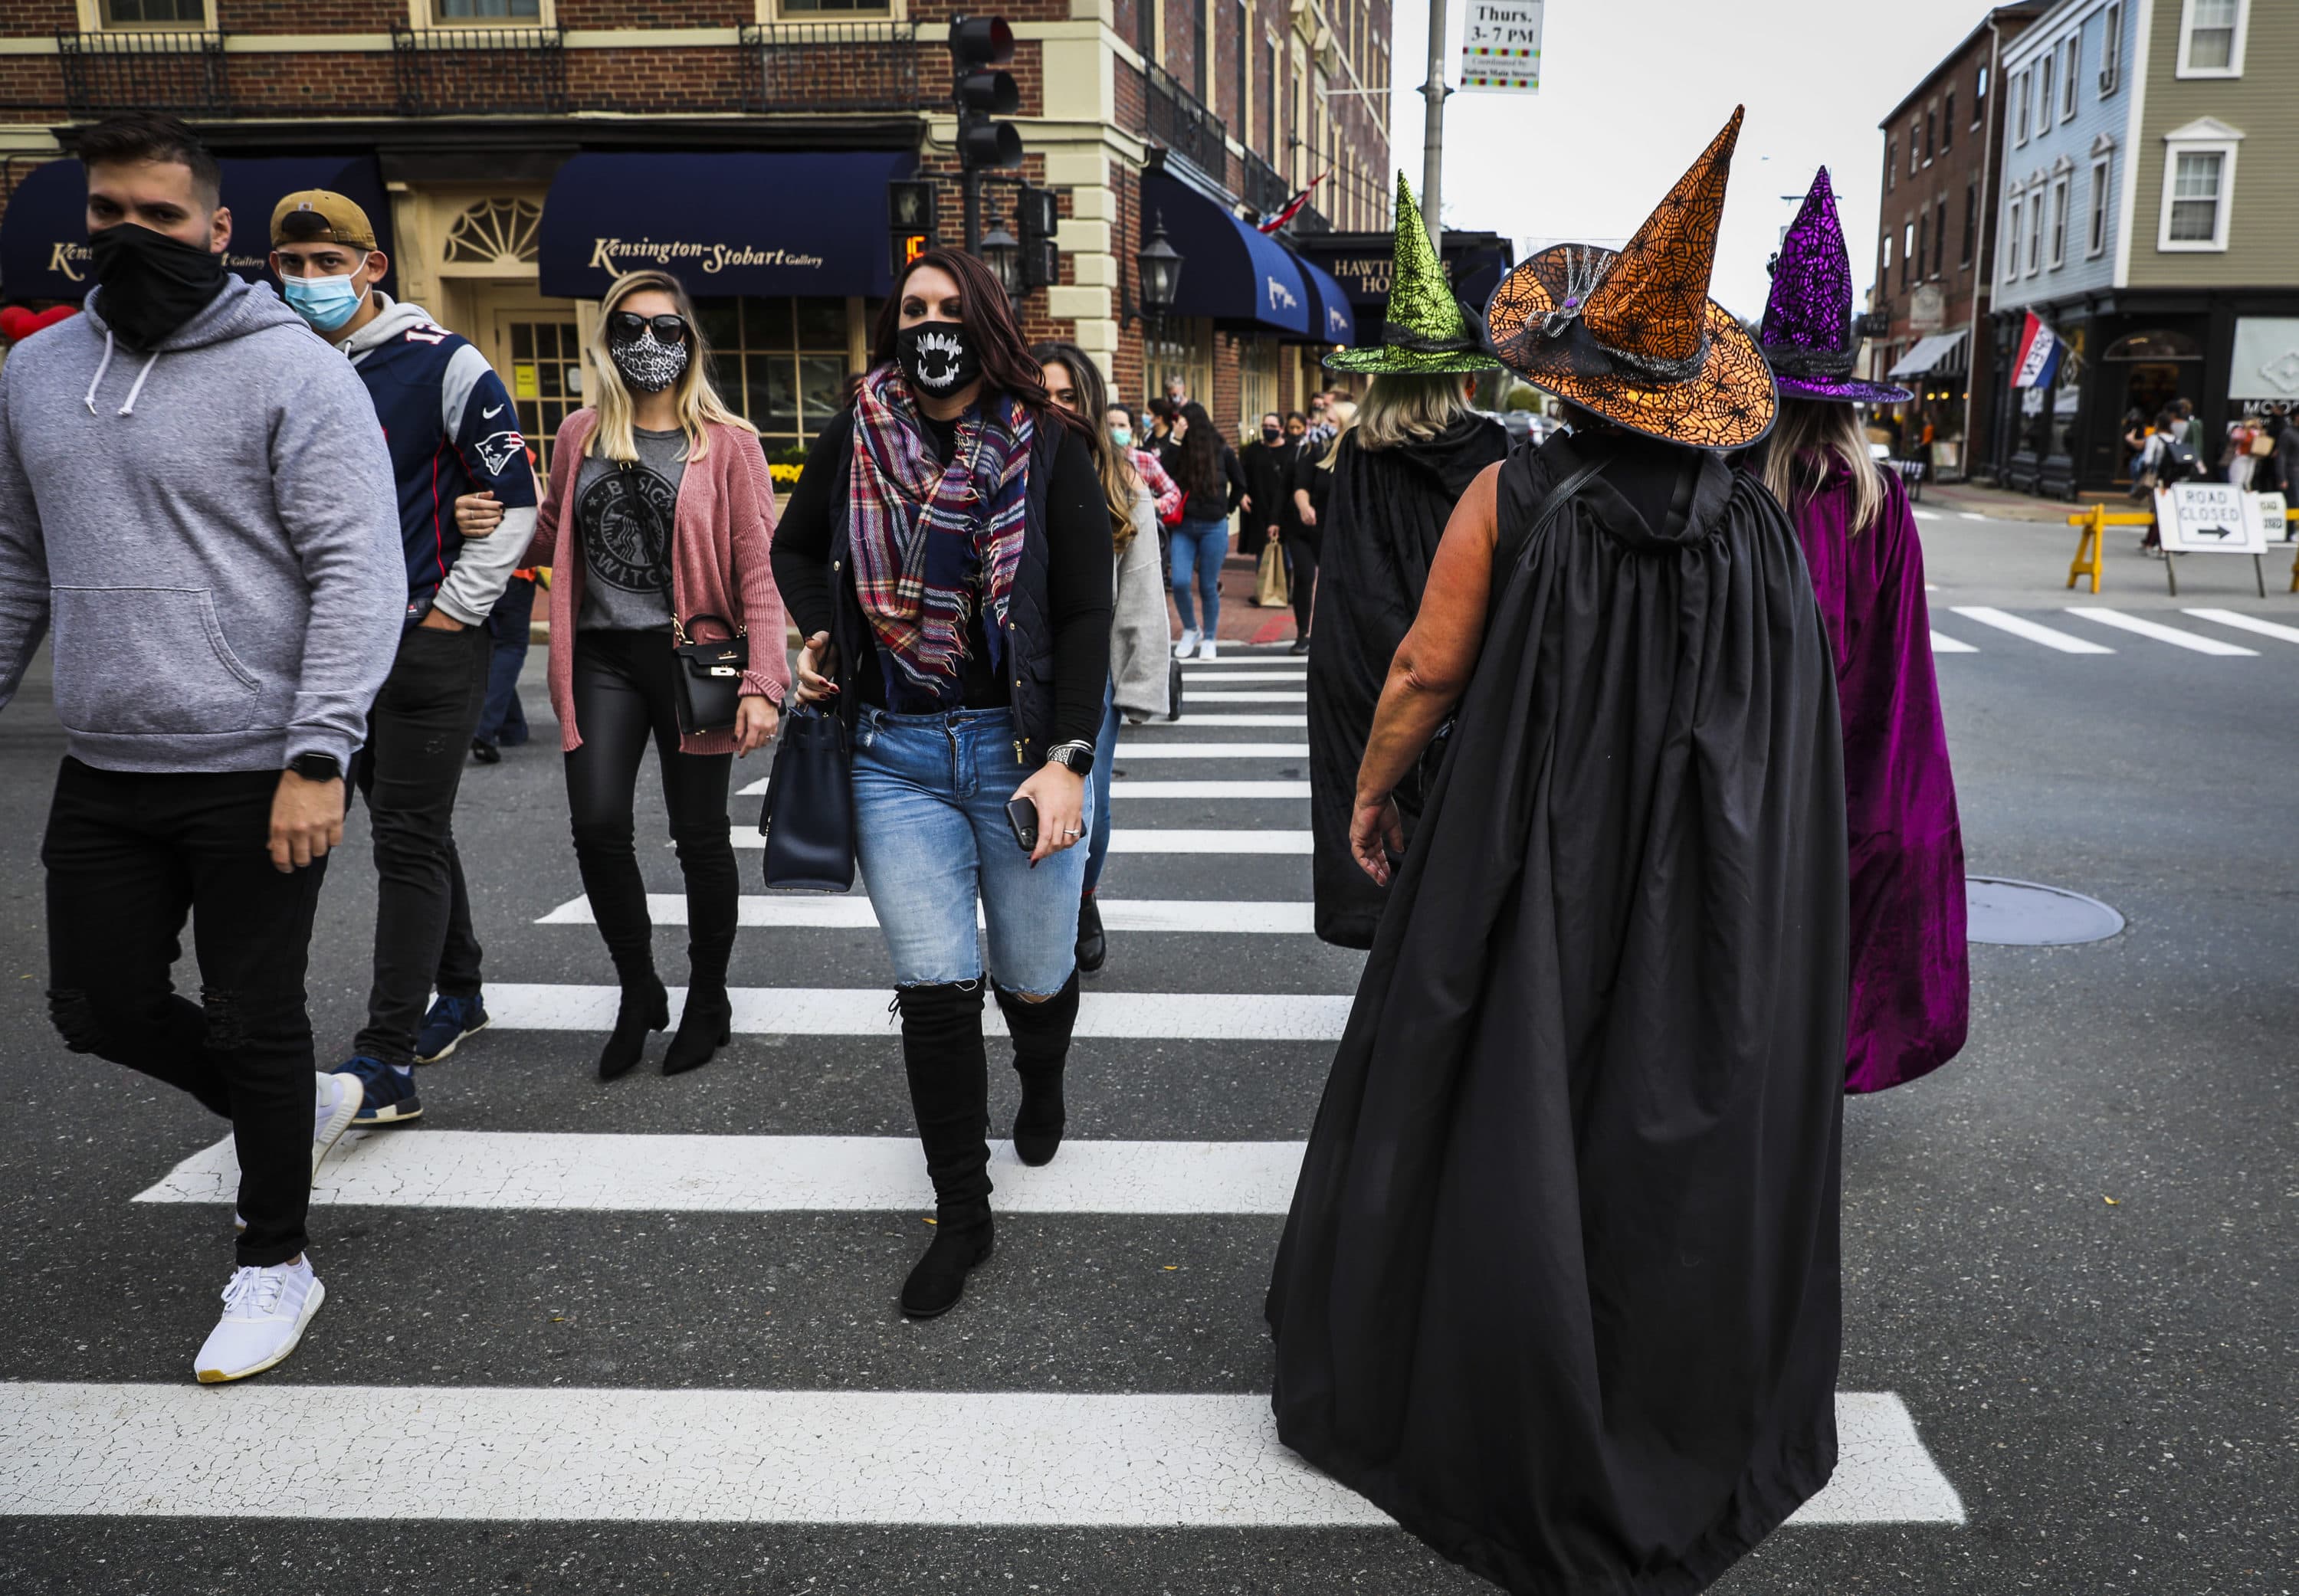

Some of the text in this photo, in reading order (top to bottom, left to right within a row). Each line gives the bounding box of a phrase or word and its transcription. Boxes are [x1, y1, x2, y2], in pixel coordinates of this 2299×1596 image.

[1476, 6, 1532, 22] Thurs.
[1471, 26, 1533, 43] 3- 7 PM
[588, 237, 824, 279] Kensington-Stobart Gallery
[1334, 260, 1452, 277] HAWTE
[607, 476, 668, 504] BSIC
[2186, 490, 2228, 504] ROAD
[2179, 508, 2239, 523] CLOSED
[597, 552, 662, 586] WITC
